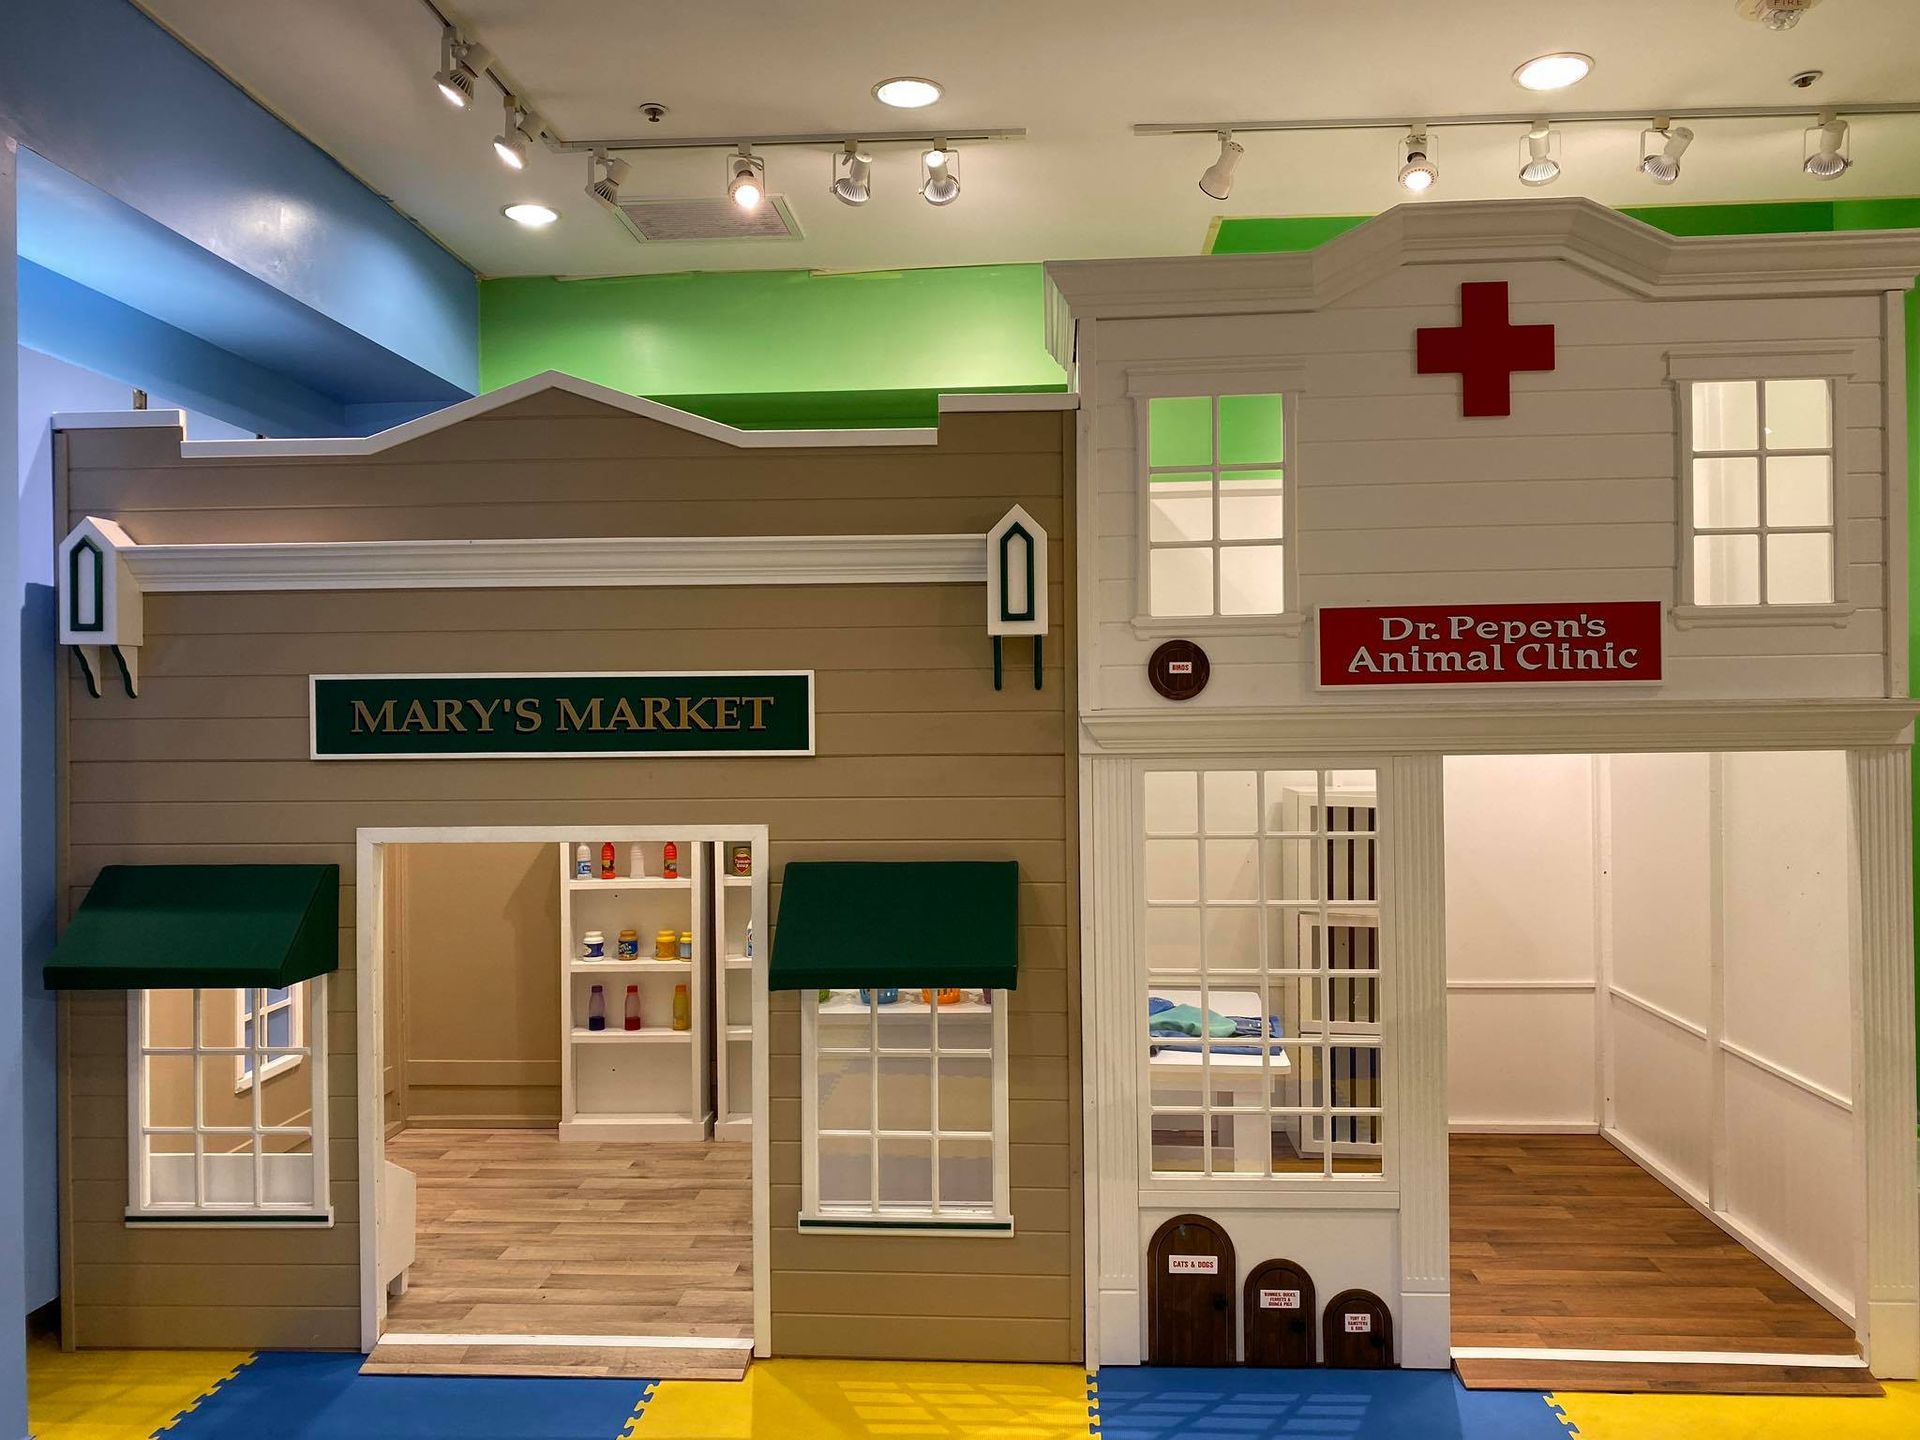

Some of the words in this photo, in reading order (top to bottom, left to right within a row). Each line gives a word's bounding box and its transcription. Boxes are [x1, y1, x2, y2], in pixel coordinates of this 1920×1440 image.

[1379, 616, 1440, 641] Dr.
[1447, 614, 1606, 644] Pepen's
[1348, 644, 1505, 673] Animal
[1516, 642, 1639, 671] Clinic
[350, 697, 543, 735] MARY'S
[556, 696, 775, 732] MARKET
[1173, 1260, 1189, 1268] CATS
